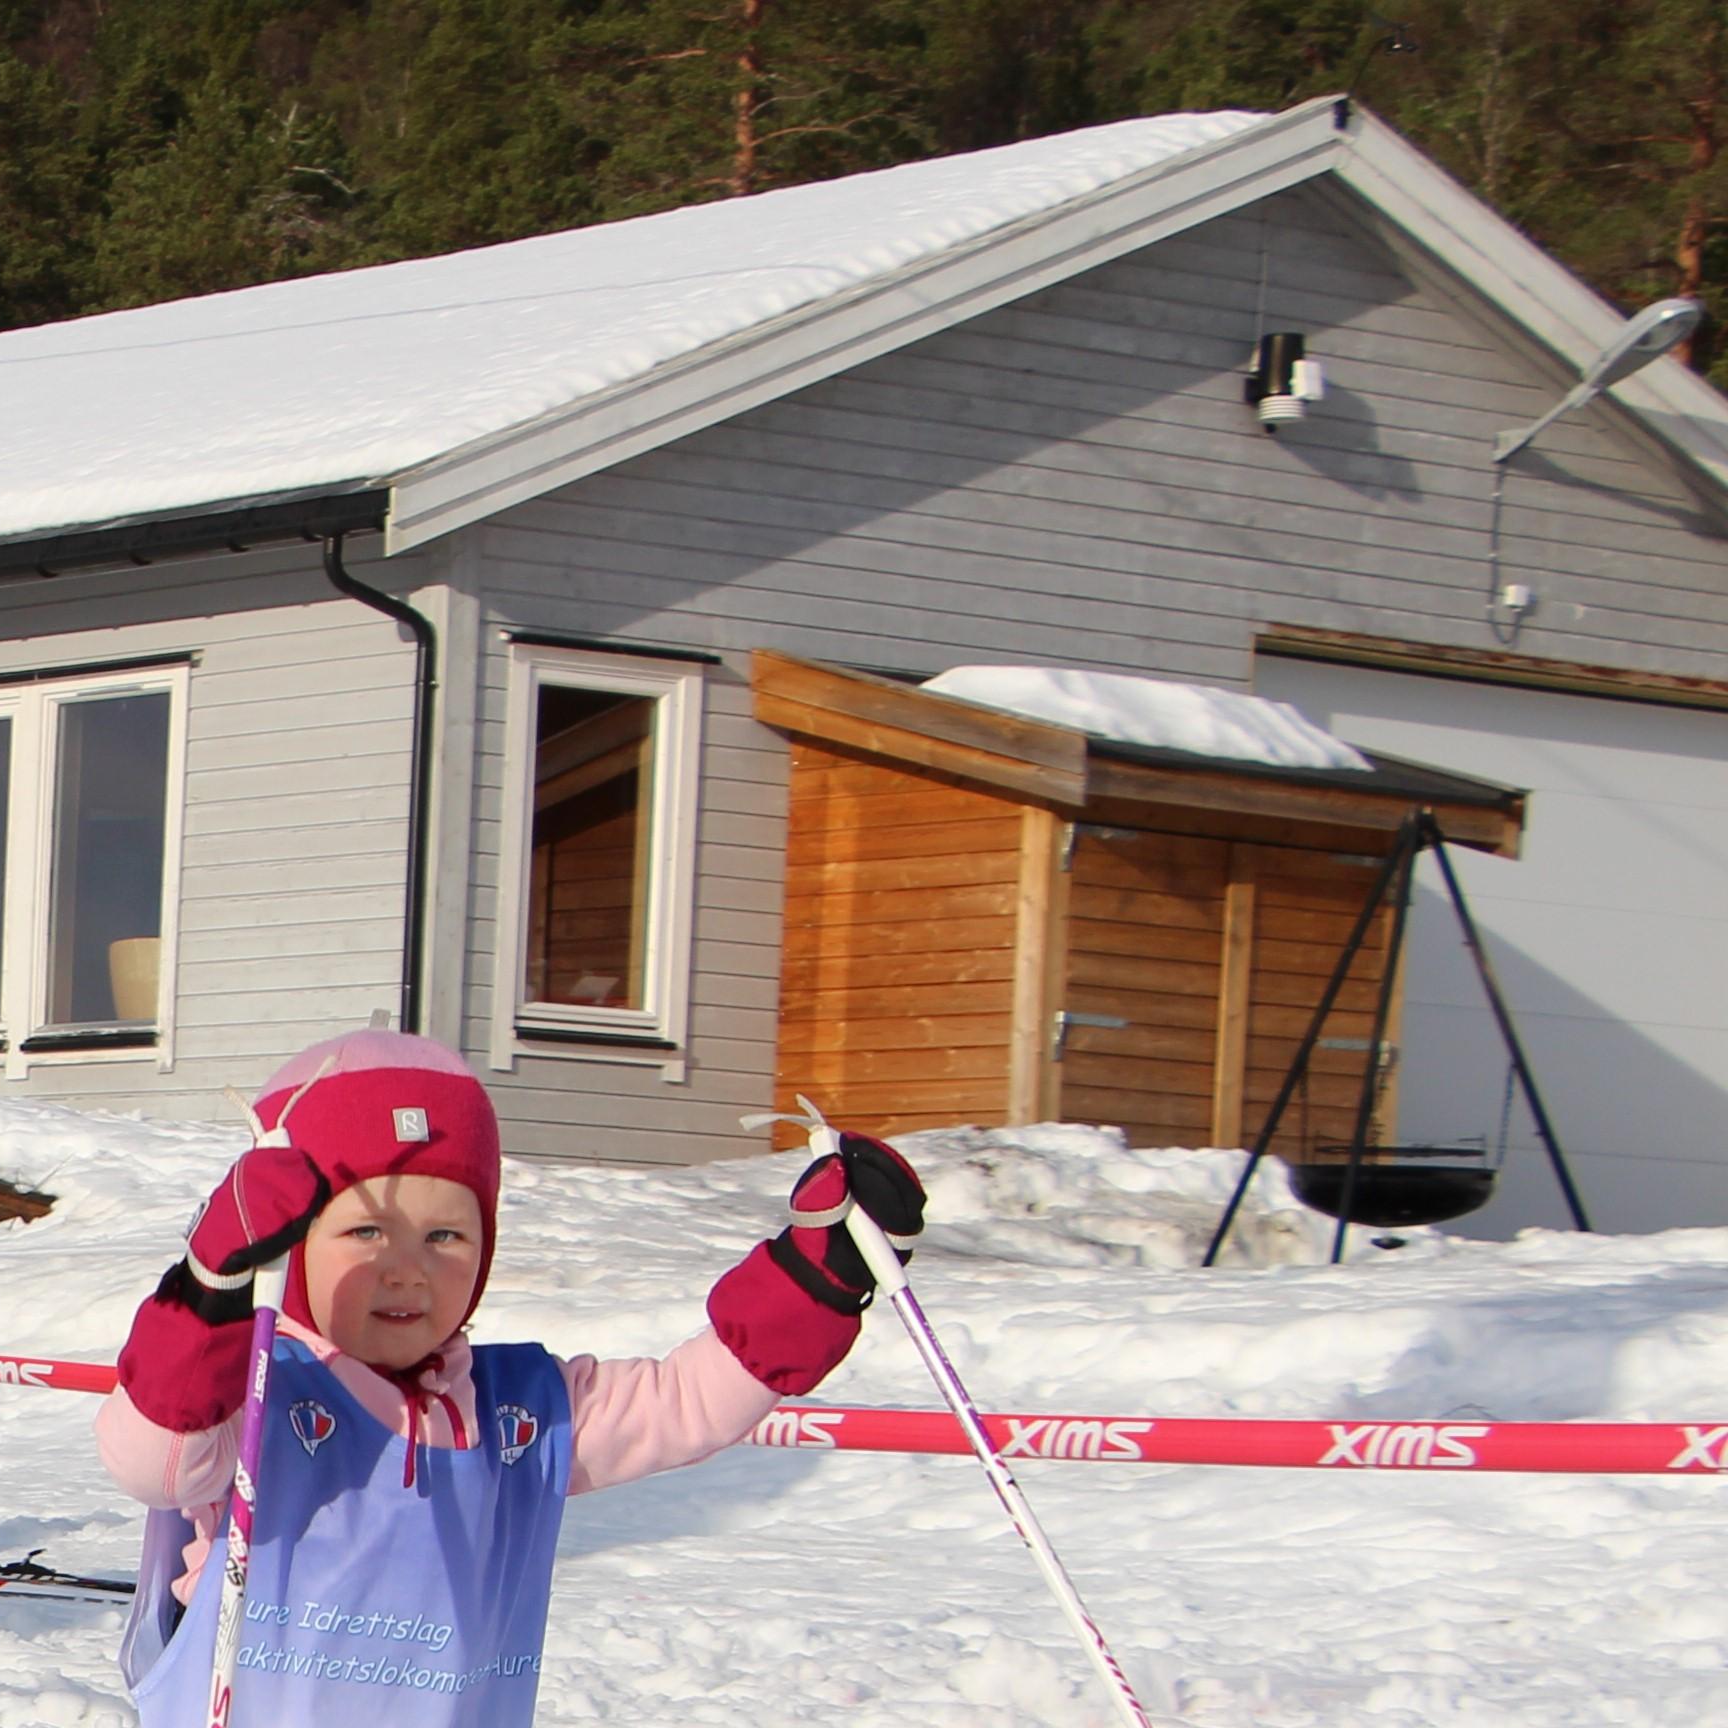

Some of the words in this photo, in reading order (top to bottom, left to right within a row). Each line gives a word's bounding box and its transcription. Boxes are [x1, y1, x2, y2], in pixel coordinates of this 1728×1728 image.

[1000, 1418, 1154, 1461] SWIX
[1317, 1423, 1493, 1467] SWIX
[245, 1599, 290, 1626] ure
[297, 1600, 453, 1652] Idrettslag
